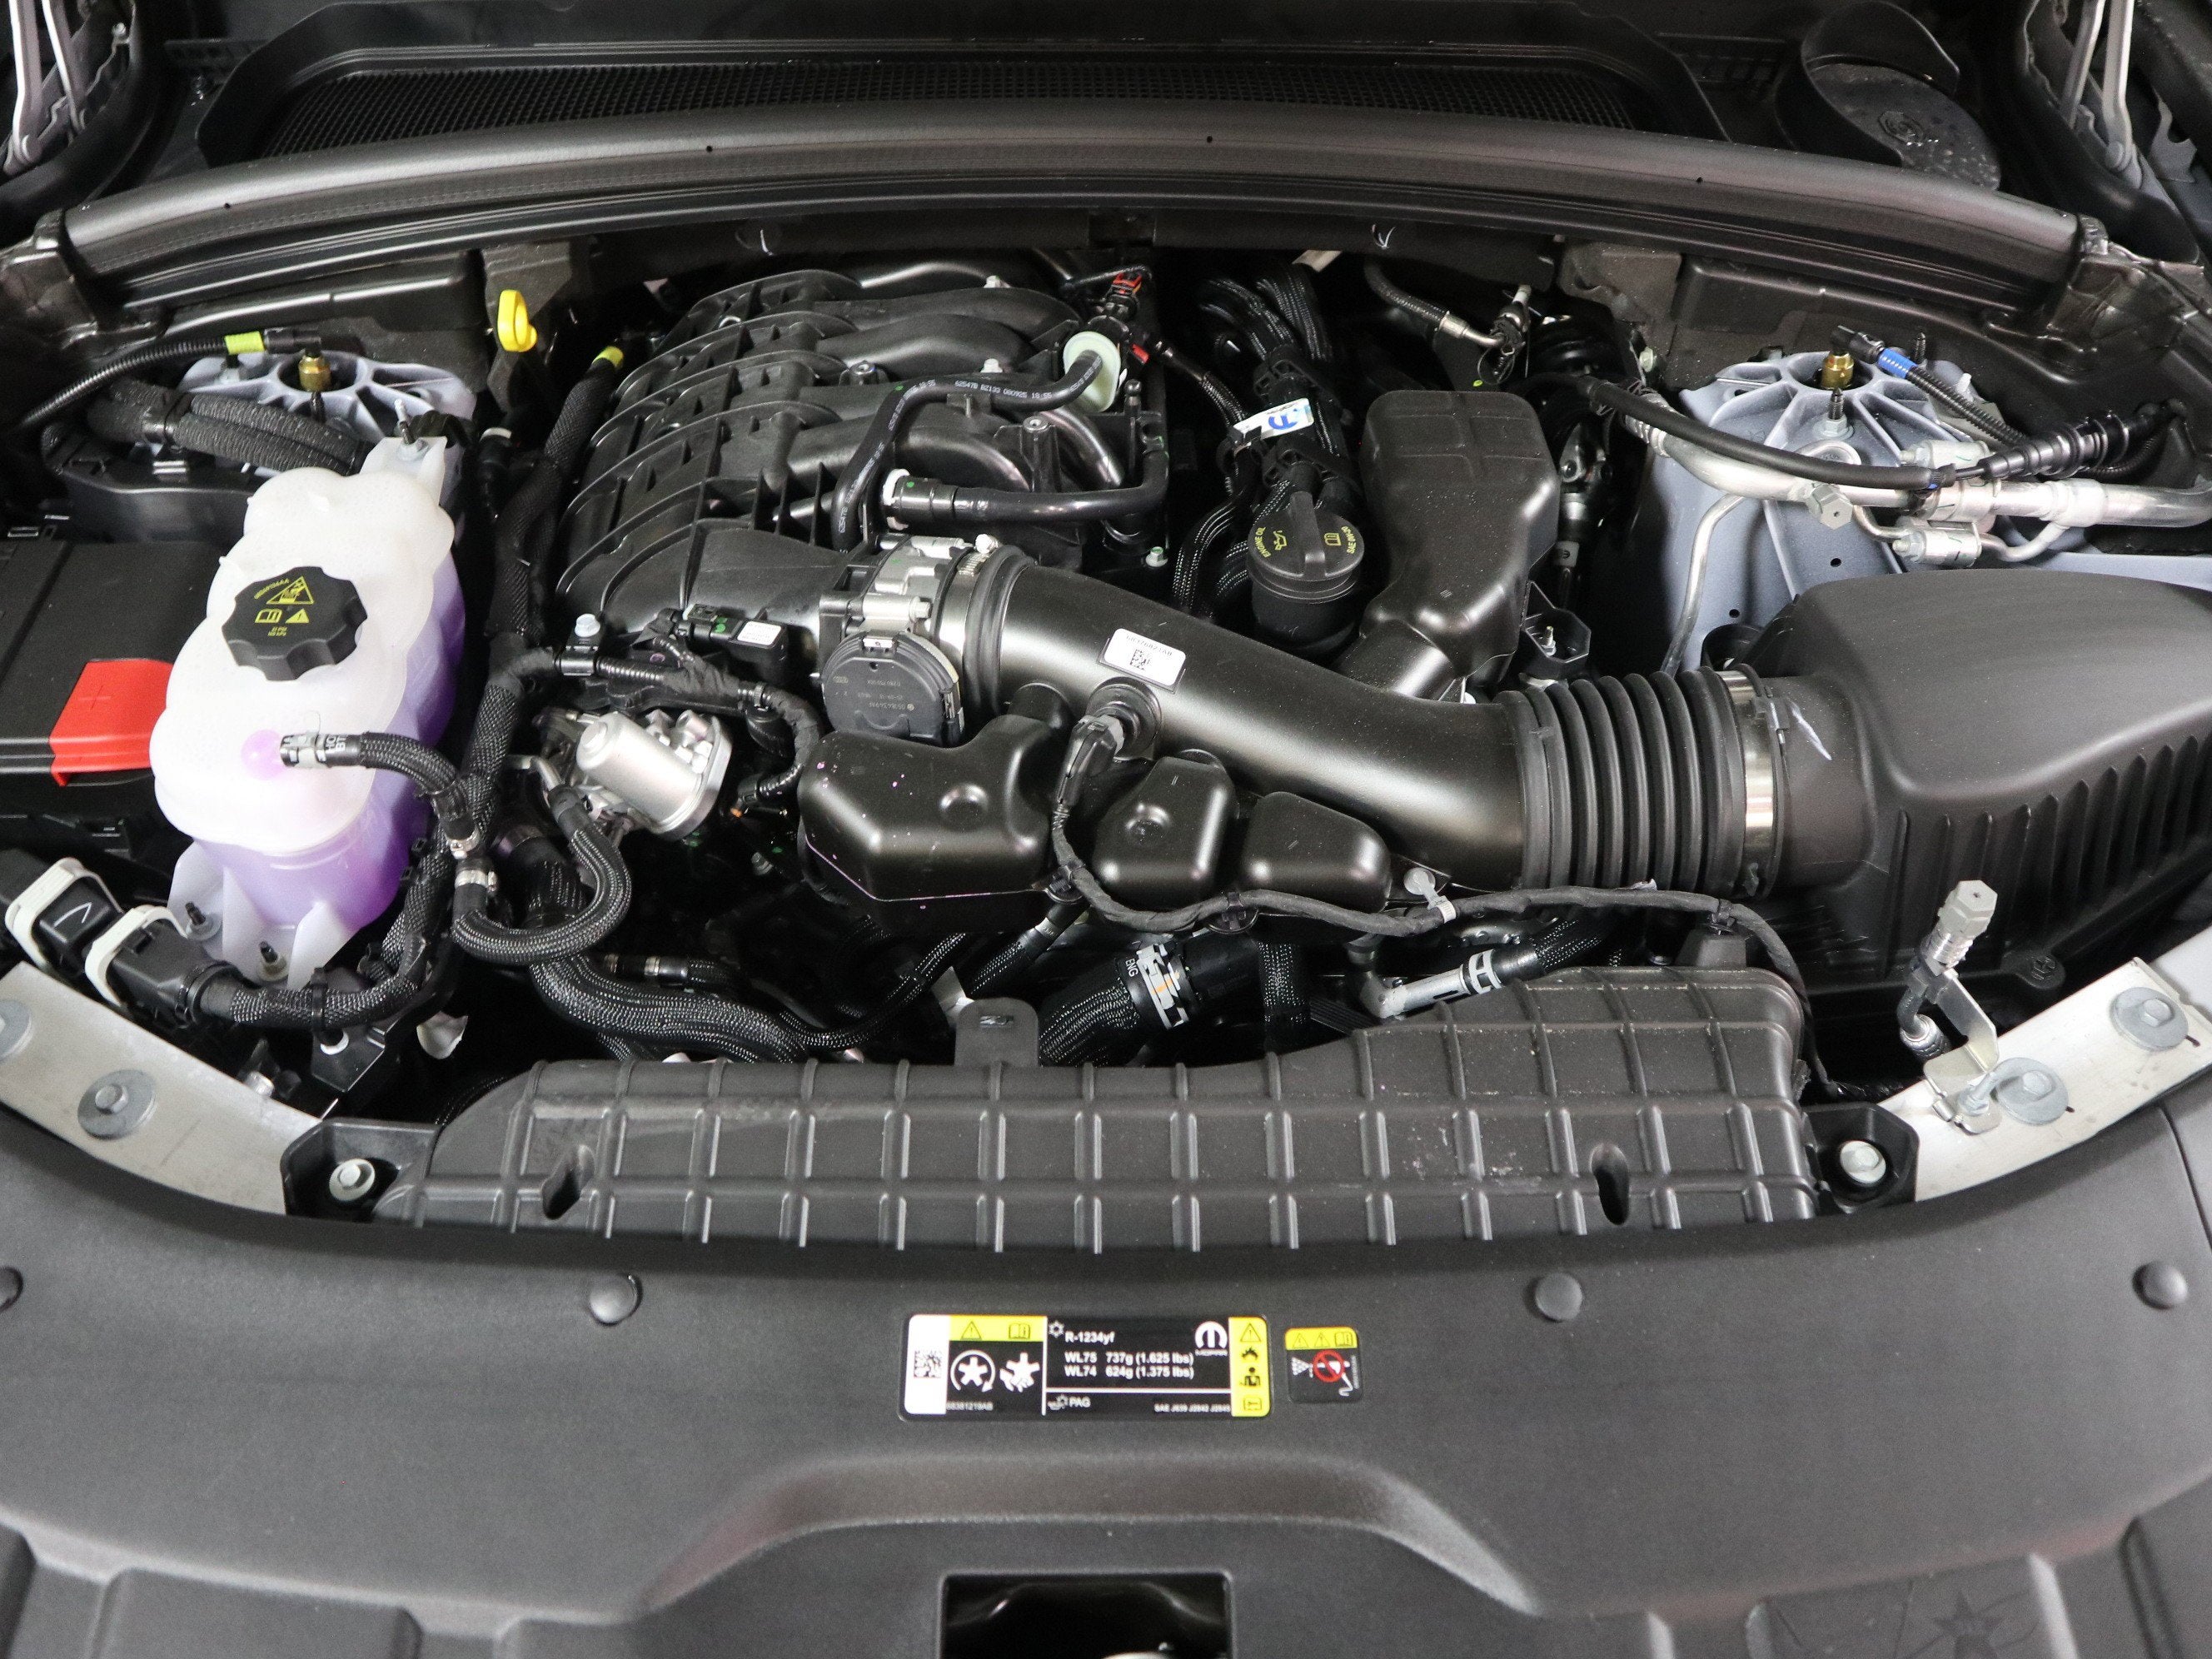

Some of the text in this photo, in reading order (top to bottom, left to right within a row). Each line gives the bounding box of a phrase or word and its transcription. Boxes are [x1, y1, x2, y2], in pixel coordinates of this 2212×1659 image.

[1255, 526, 1271, 558] ENGINE OIL
[1346, 542, 1357, 555] SAE
[1125, 959, 1138, 977] ENG
[1064, 1331, 1115, 1345] R-1234yf
[1064, 1351, 1194, 1366] WL75 737g (1.625 lbs)
[1064, 1365, 1194, 1380] WL74 624g (1.375 lbs)
[1069, 1397, 1091, 1408] PAG
